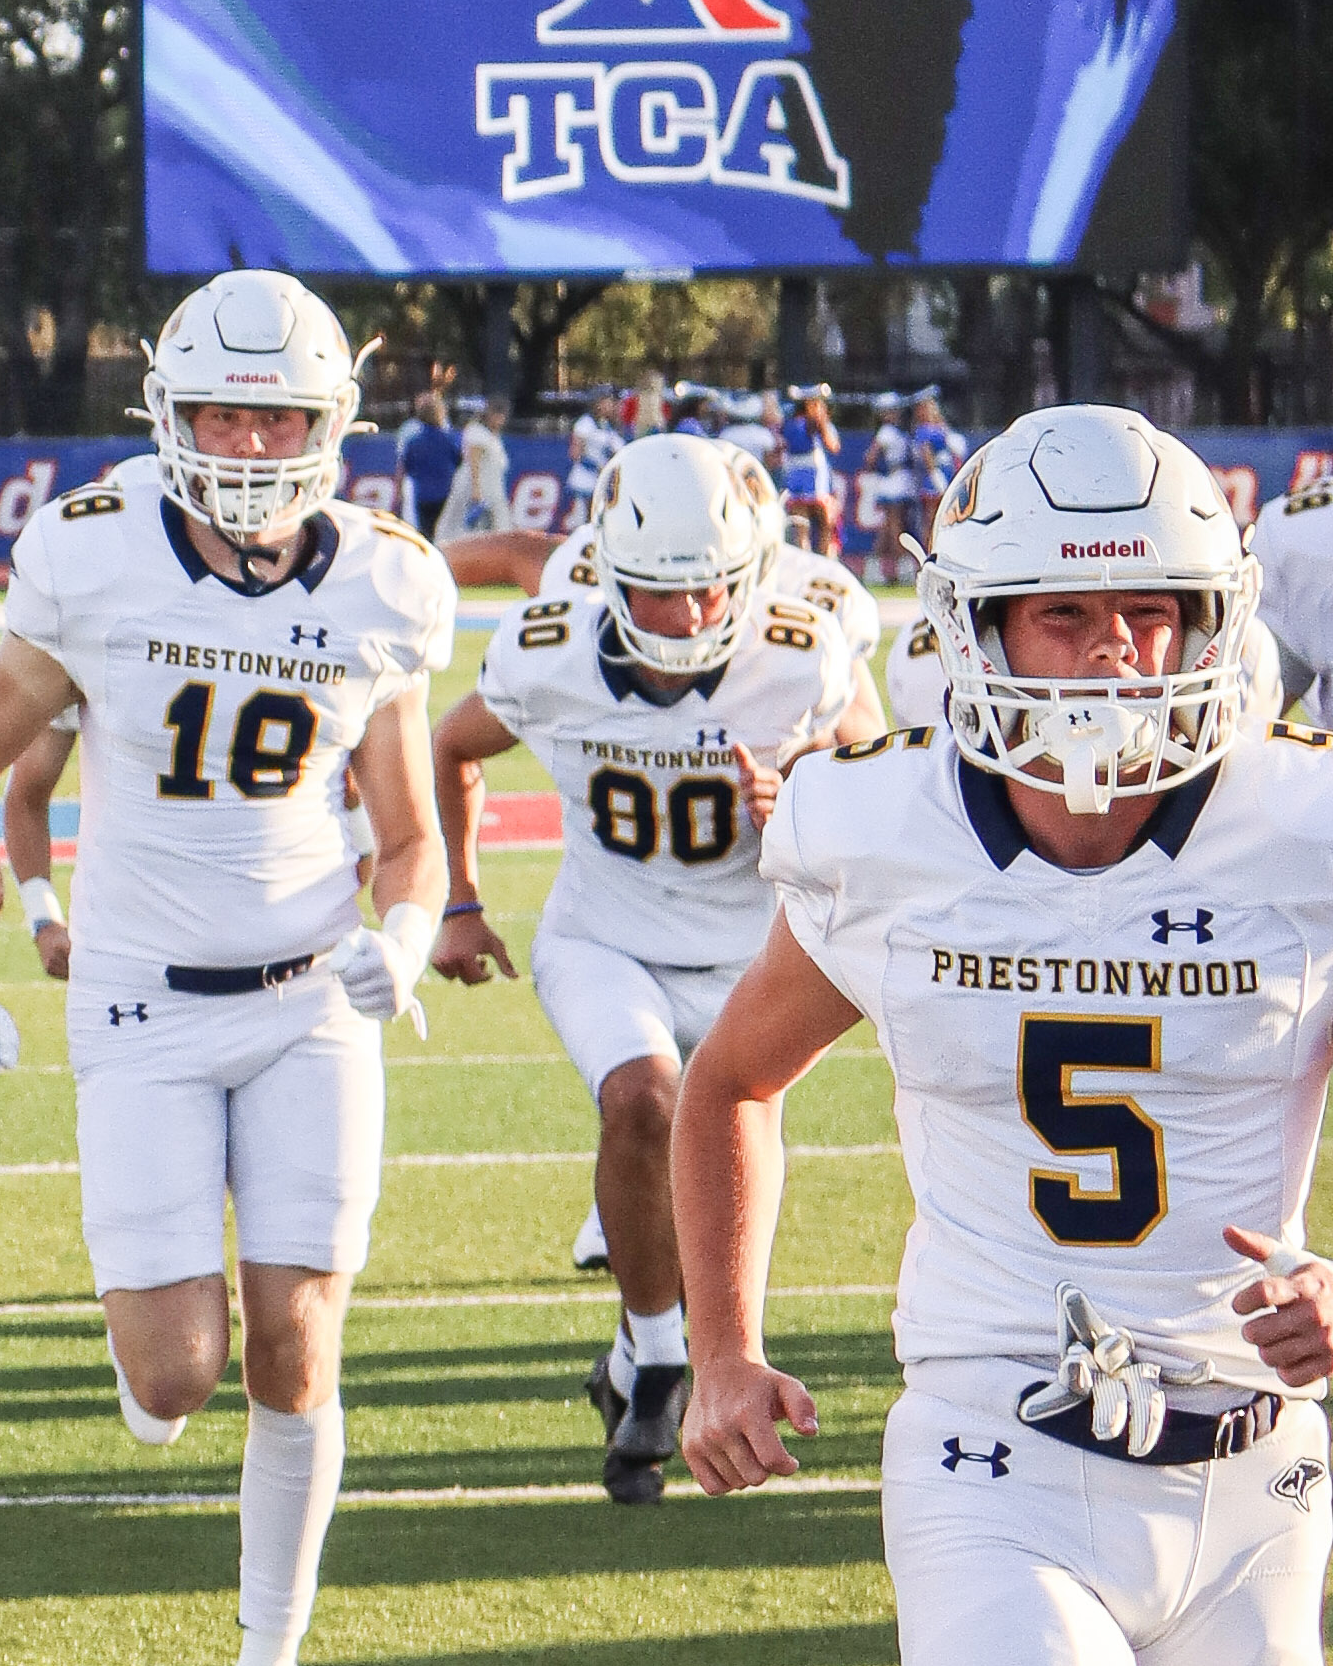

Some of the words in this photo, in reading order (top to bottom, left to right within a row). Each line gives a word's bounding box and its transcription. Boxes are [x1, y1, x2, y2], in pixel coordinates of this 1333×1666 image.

[475, 58, 852, 209] TCA
[1060, 539, 1146, 559] Riddell
[147, 639, 347, 686] PRESTONWOOD
[156, 678, 320, 801] 18
[583, 740, 738, 769] PRESTONWOO
[588, 763, 739, 866] 80
[931, 948, 1260, 998] PRESTONWOOD
[1016, 1011, 1169, 1248] 5
